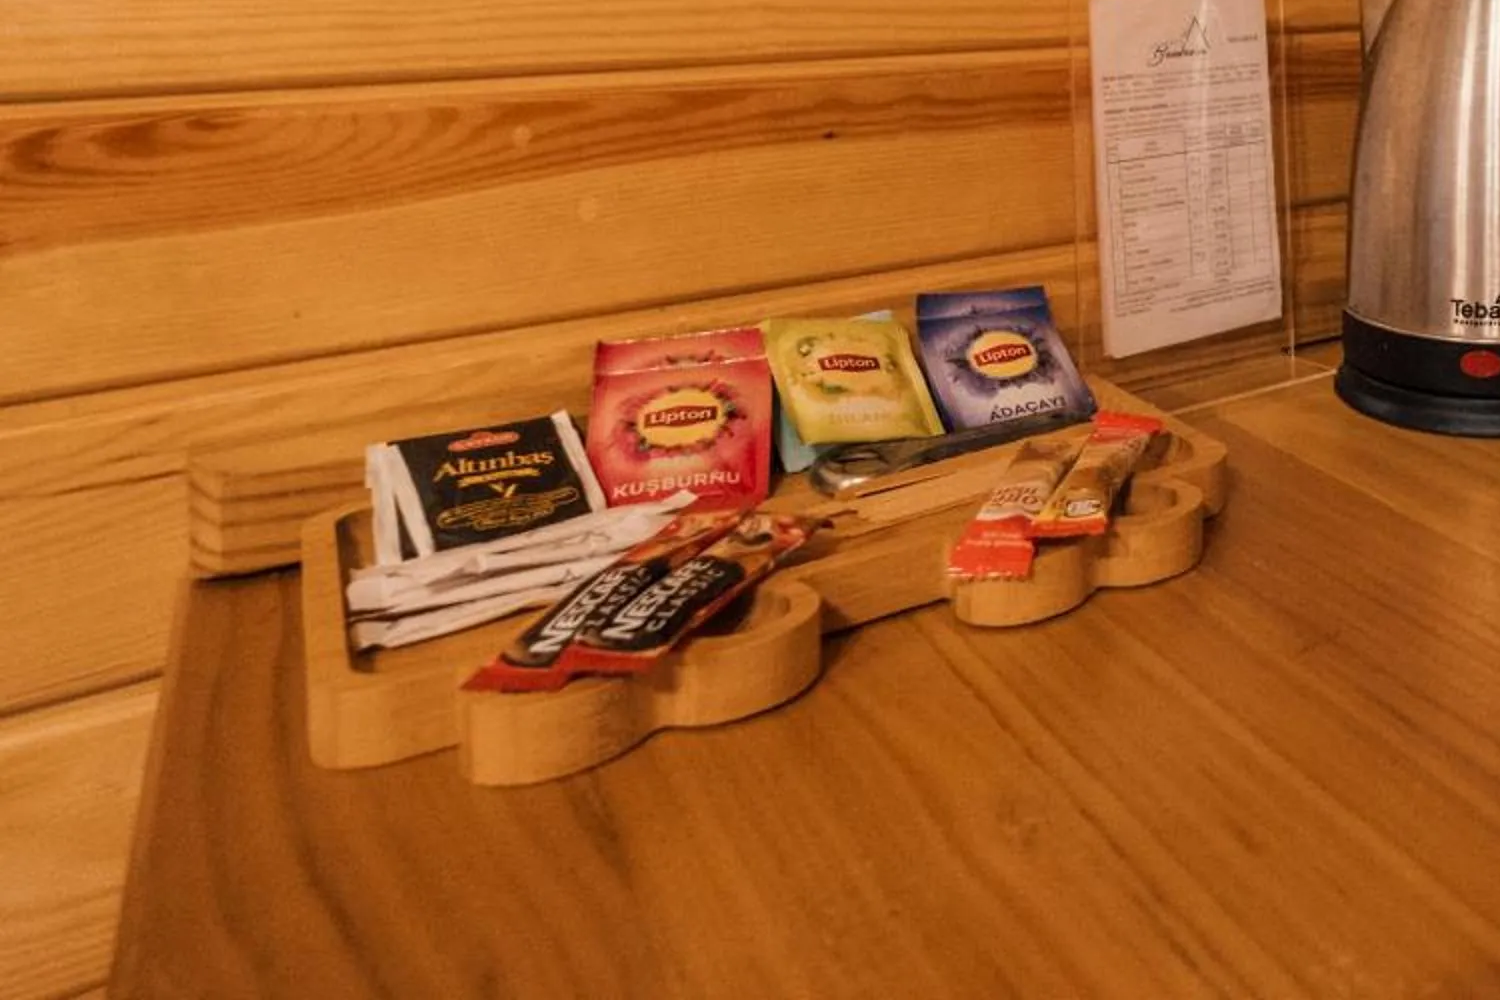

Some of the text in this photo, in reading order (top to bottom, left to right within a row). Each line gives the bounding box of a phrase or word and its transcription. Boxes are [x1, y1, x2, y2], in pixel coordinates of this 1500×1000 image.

[978, 345, 1027, 363] Lipton
[823, 357, 877, 370] Lipton
[650, 408, 712, 425] Lipton
[611, 470, 741, 500] KUŞBURNU
